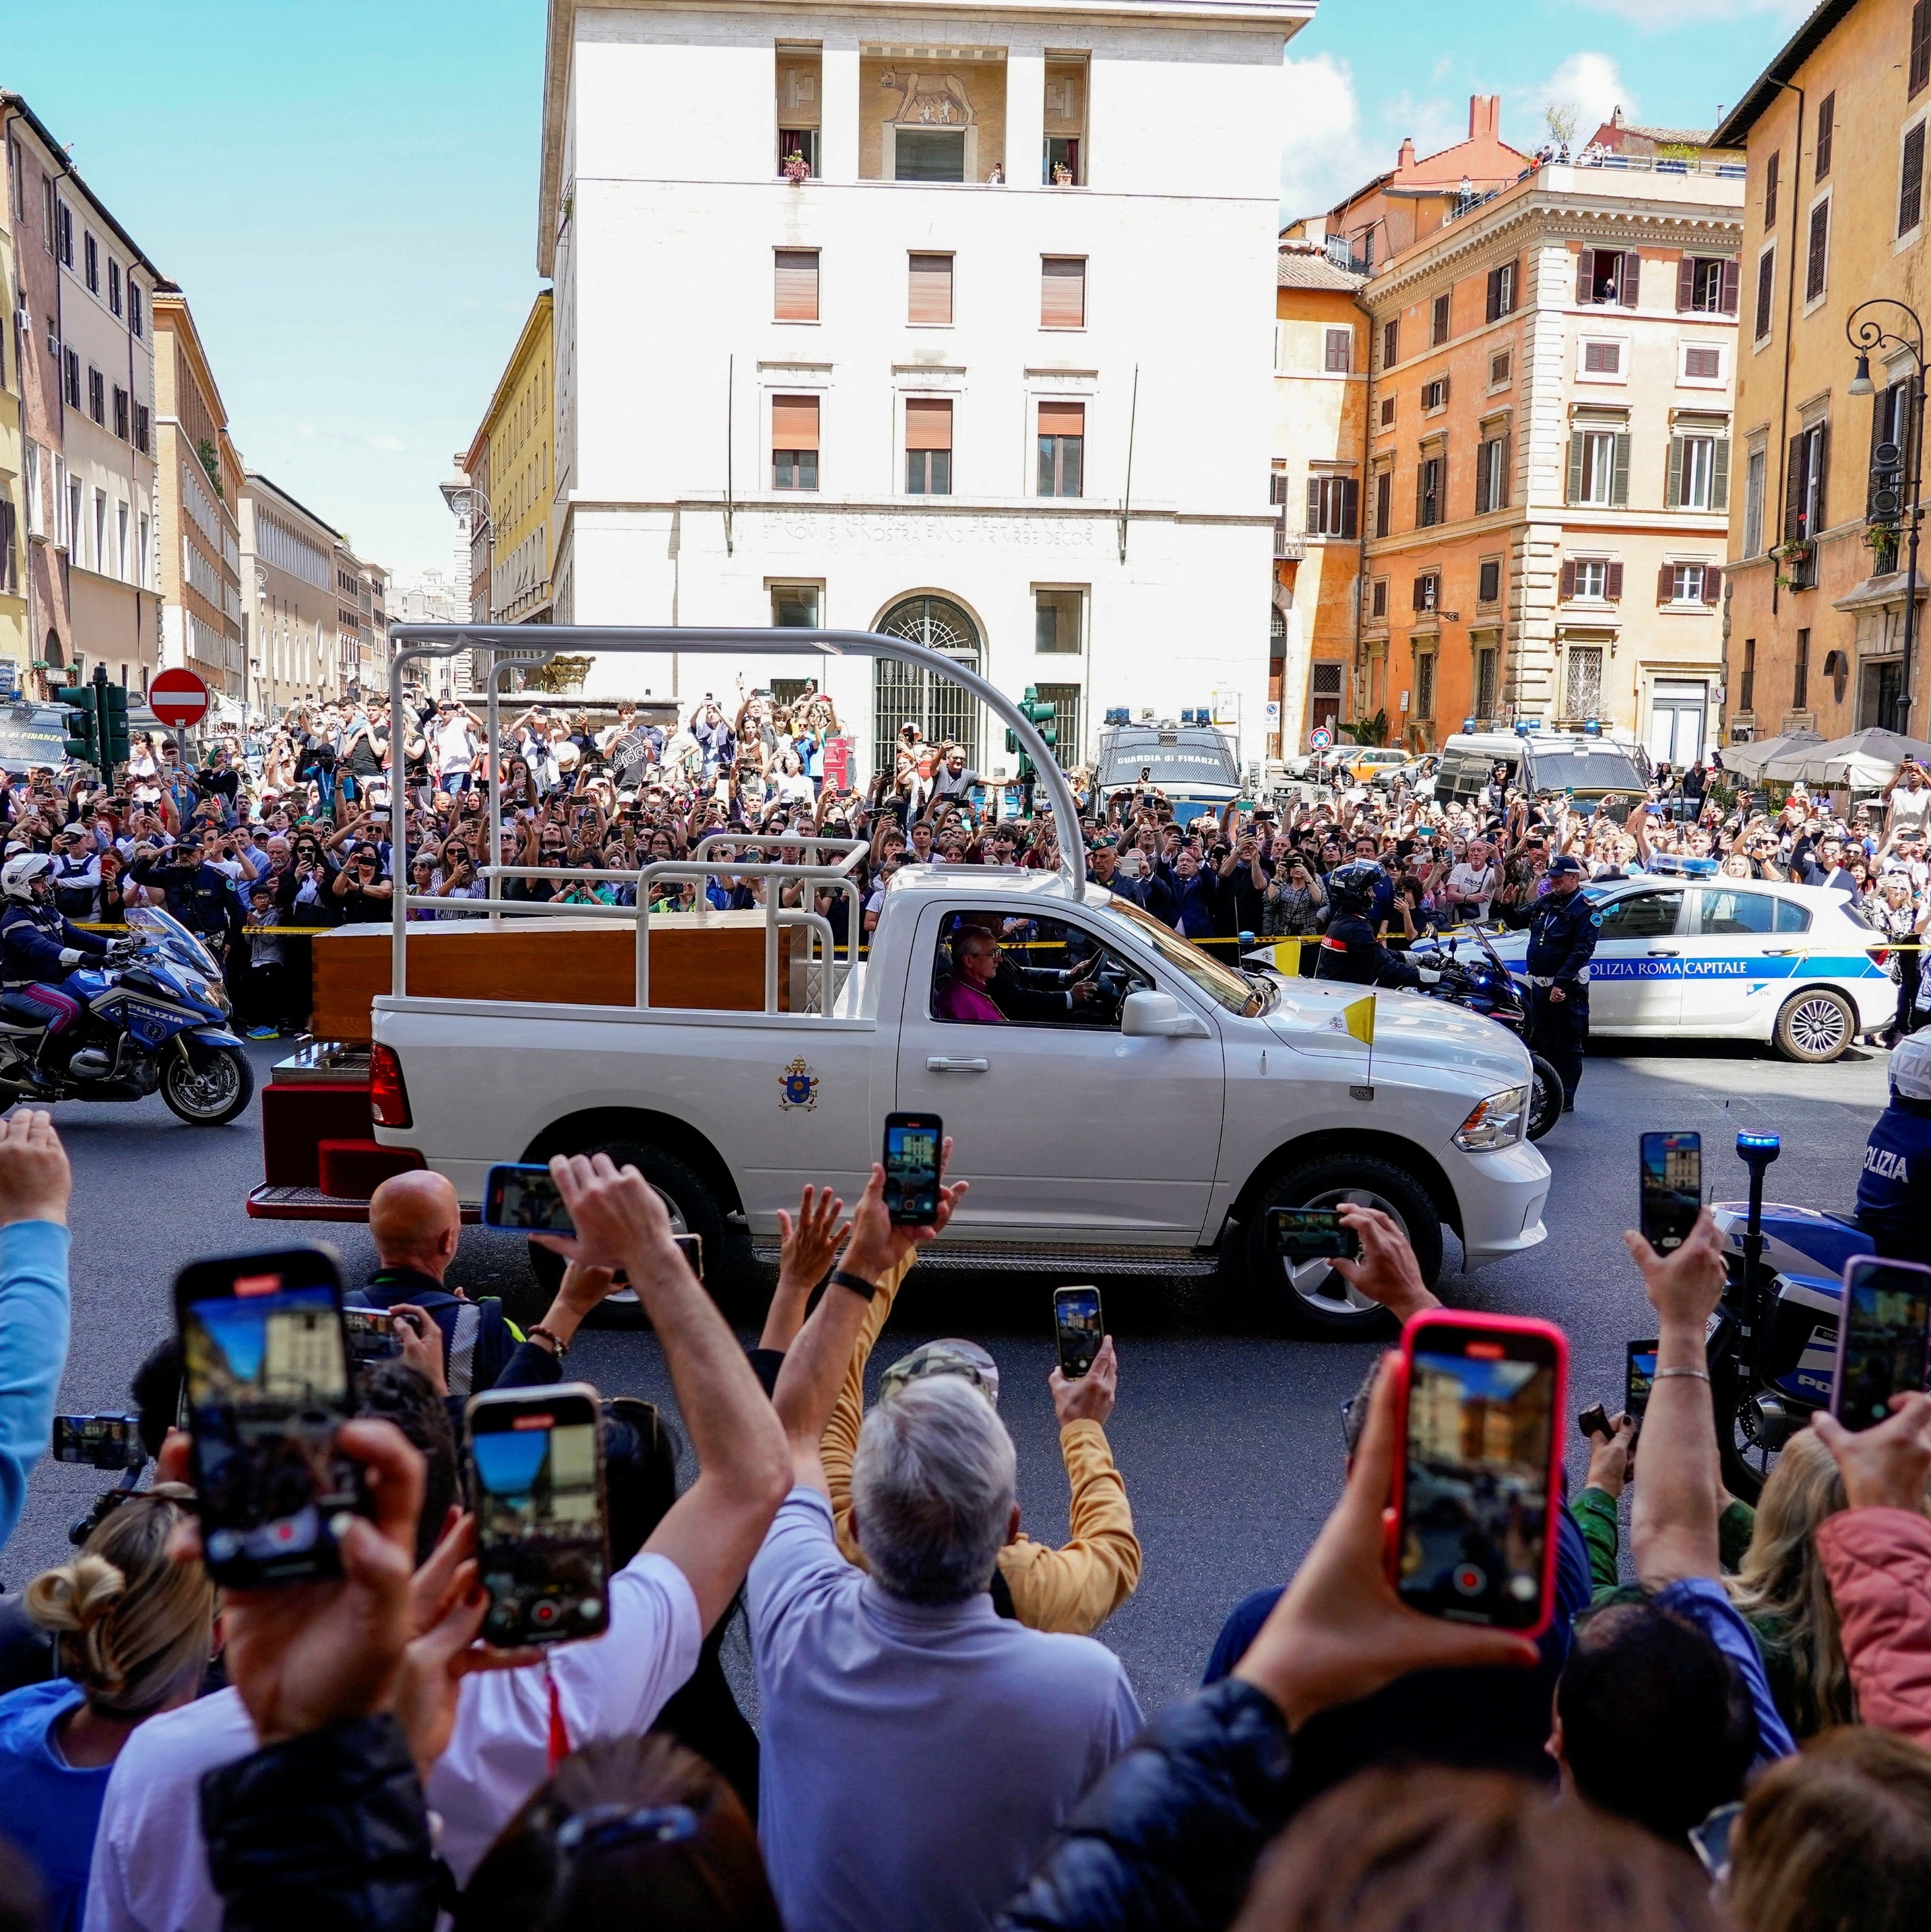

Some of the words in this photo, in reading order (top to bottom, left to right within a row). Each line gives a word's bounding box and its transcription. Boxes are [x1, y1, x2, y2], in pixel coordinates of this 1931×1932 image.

[828, 512, 867, 525] FNES
[22, 732, 62, 742] FINANZA
[1117, 754, 1162, 764] GUARDIA
[1164, 754, 1174, 762] di
[1178, 754, 1220, 766] FINANZA
[1588, 963, 1634, 975] OLIZIA
[1638, 962, 1683, 975] ROMA
[1684, 962, 1748, 974] CAPITALE
[127, 1003, 183, 1024] POLIZIA
[1893, 1053, 1931, 1081] IZIA
[1863, 1145, 1909, 1183] OLIZIA
[1797, 1374, 1833, 1394] PO
